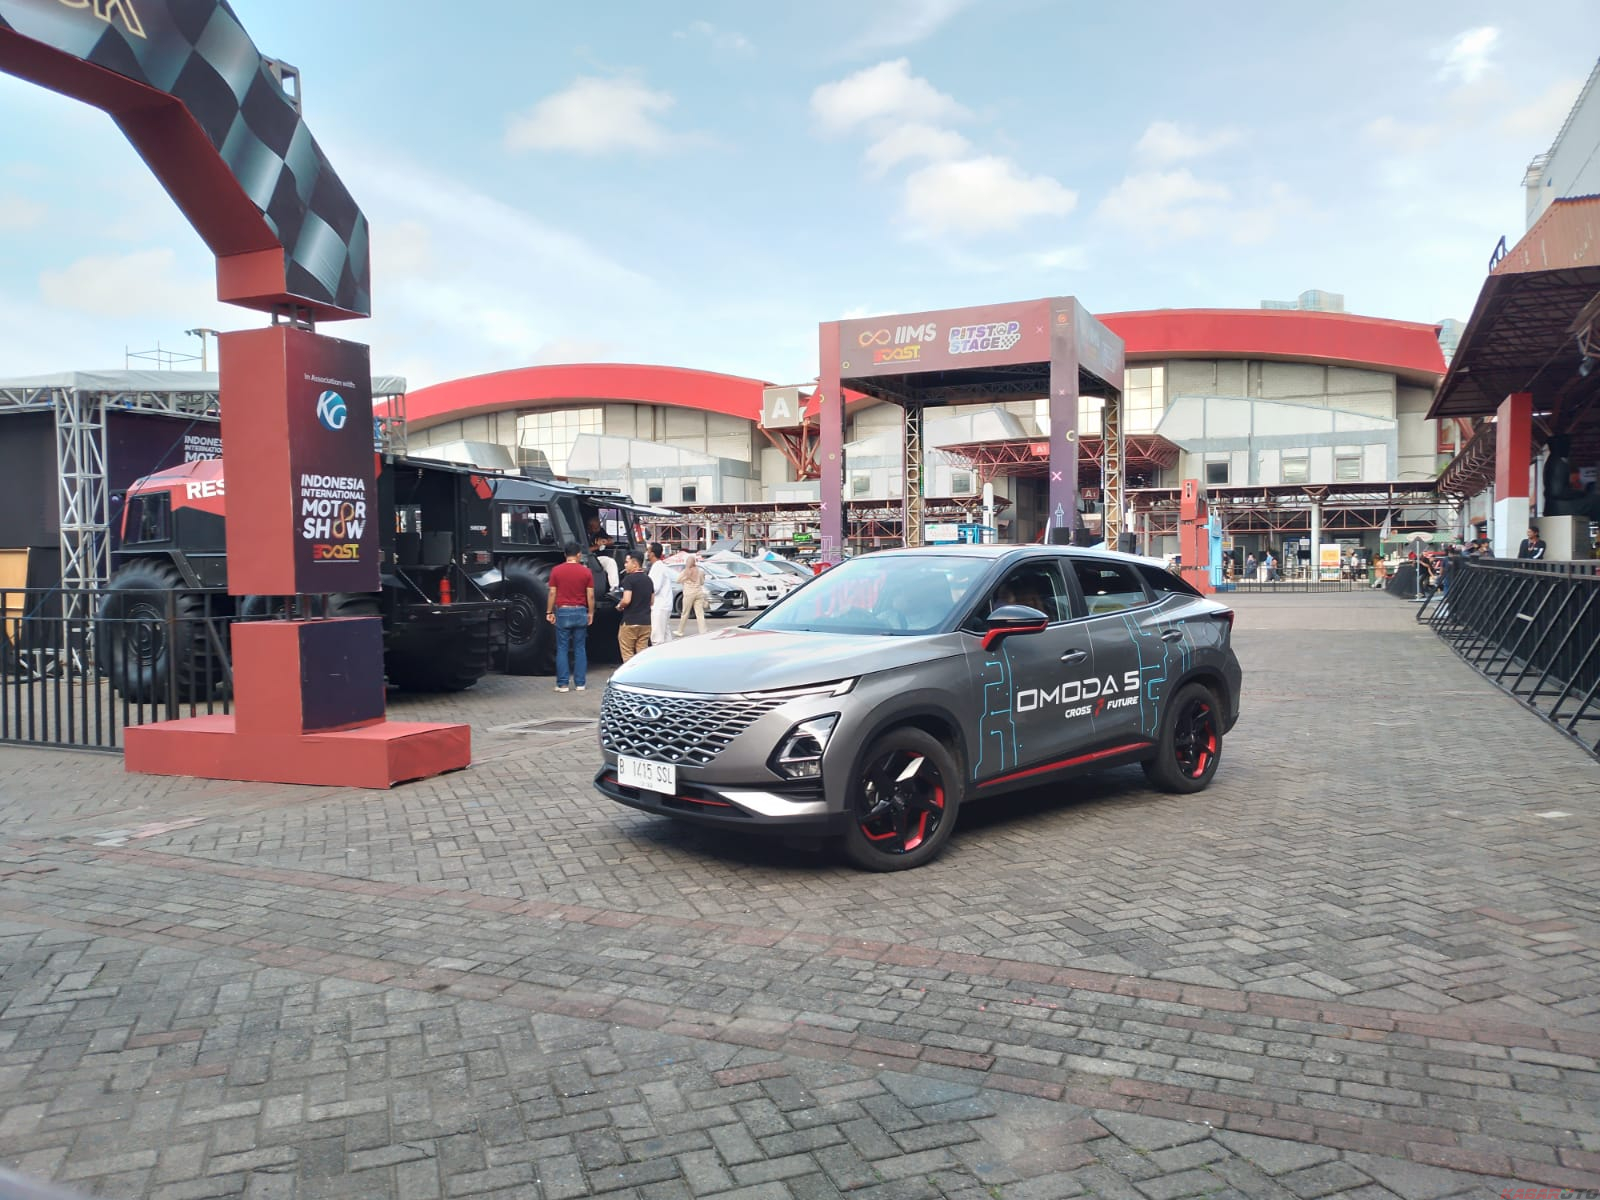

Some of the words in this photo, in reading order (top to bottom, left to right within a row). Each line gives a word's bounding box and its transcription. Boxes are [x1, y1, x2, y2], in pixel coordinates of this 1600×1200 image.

[895, 323, 936, 344] IIMS
[950, 321, 1019, 340] PITSTOP
[950, 337, 1002, 352] STAGE
[311, 374, 342, 386] Association
[772, 397, 791, 418] A
[301, 474, 365, 491] INDONESIA
[301, 488, 365, 500] INTERNATIONAL
[302, 499, 366, 520] MOTOR
[303, 518, 367, 540] SHOW
[1017, 675, 1119, 713] OMODA
[1065, 705, 1092, 719] CROSS
[1107, 696, 1139, 710] FUTURE
[620, 758, 624, 774] B
[633, 760, 653, 780] 1415
[656, 766, 673, 785] SSL
